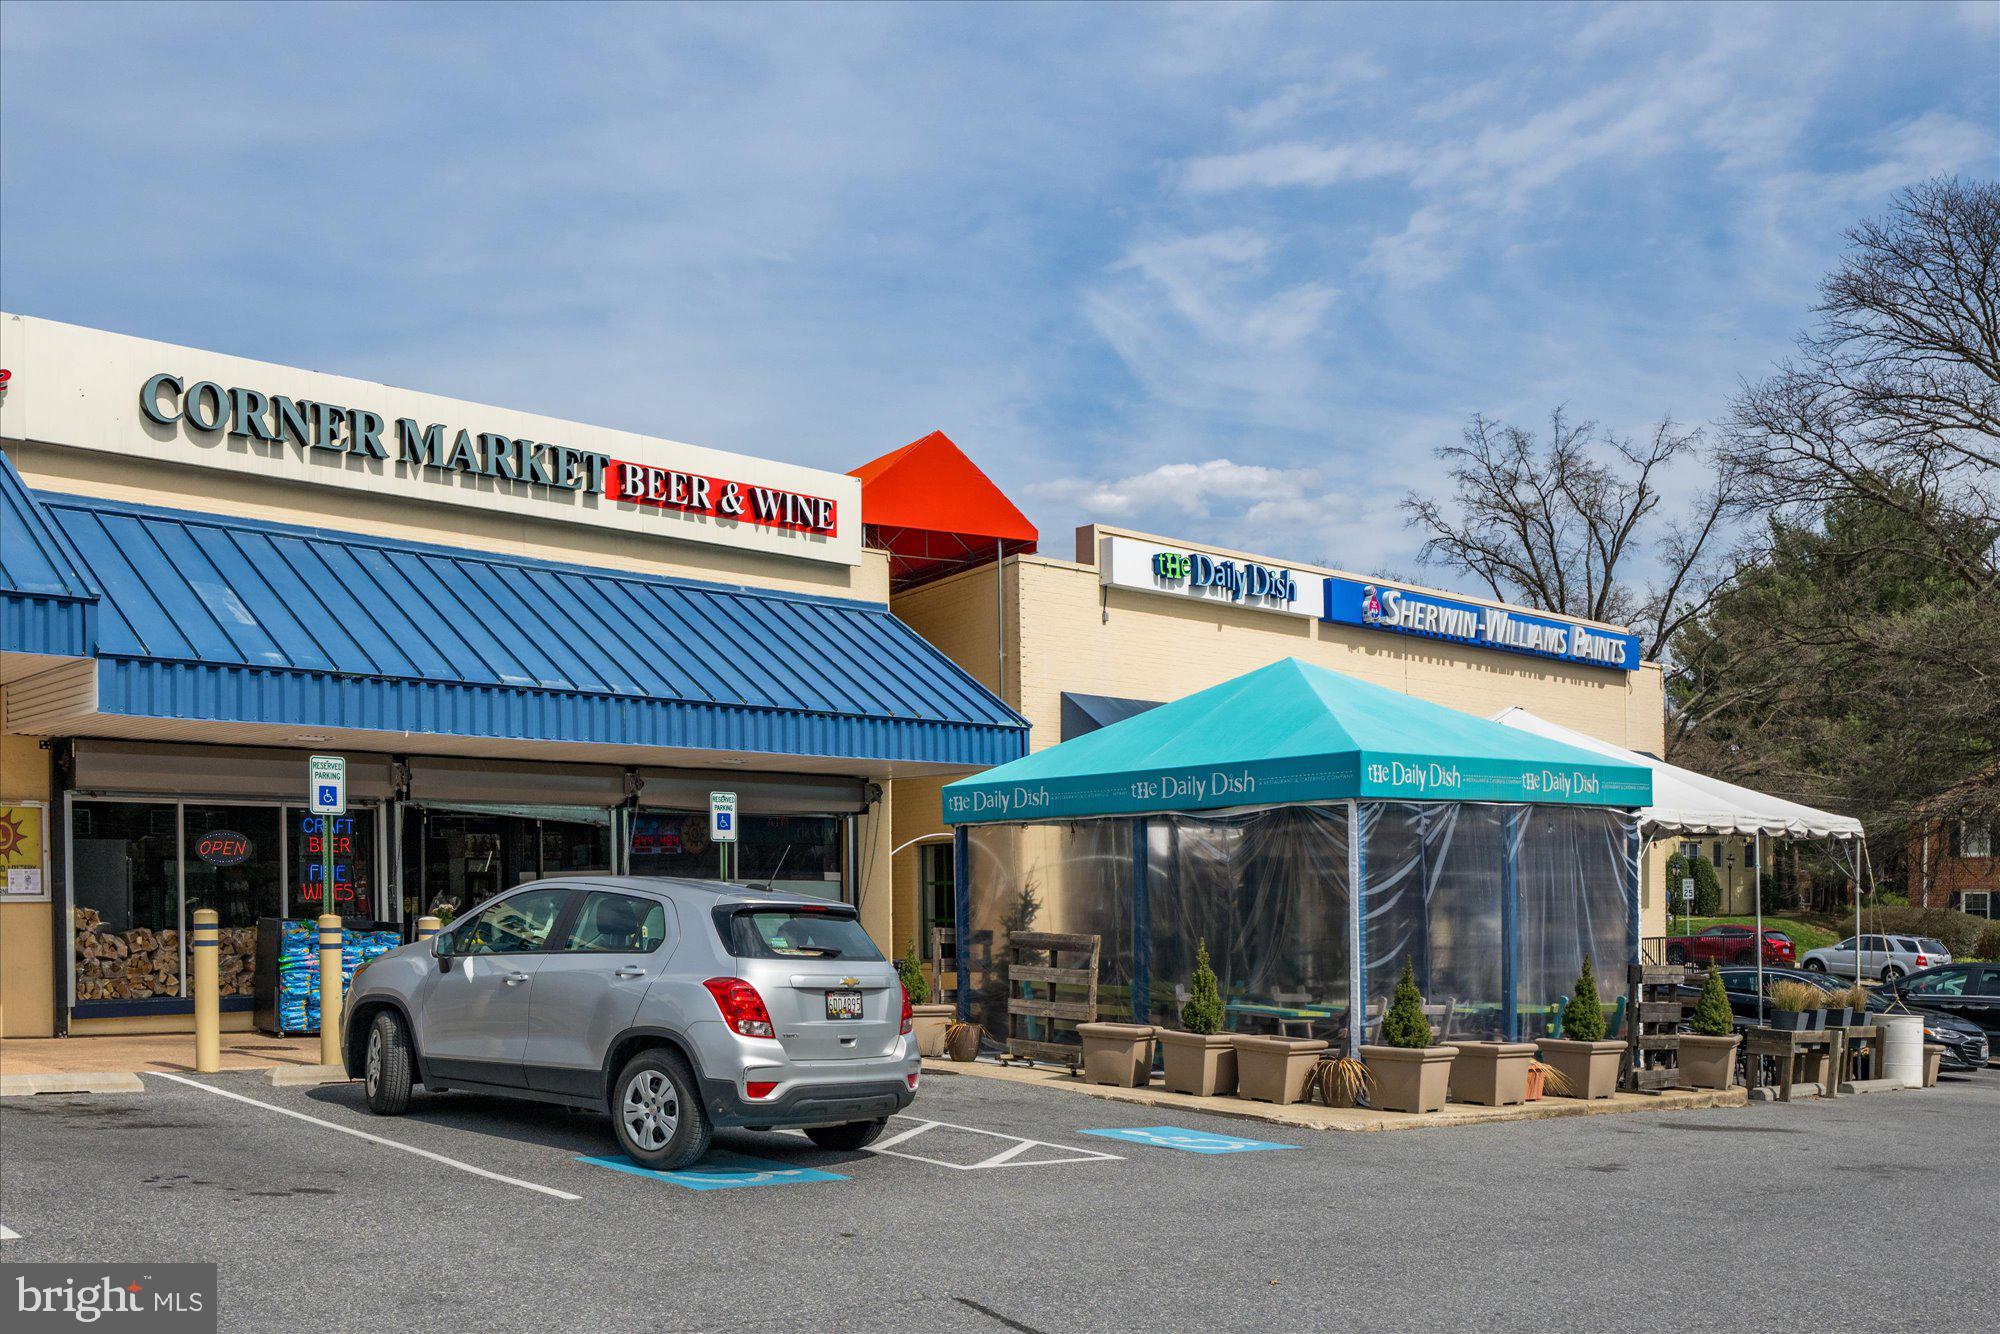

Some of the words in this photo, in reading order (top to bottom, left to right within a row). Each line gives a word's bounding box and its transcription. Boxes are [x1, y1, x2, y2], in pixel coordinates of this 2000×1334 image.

[140, 373, 389, 460] CORNER
[395, 417, 610, 493] MARKET
[619, 463, 712, 509] BEER
[719, 482, 745, 514] &
[750, 487, 833, 530] WINE
[1191, 554, 1247, 600] Daily
[1246, 563, 1297, 601] Dish
[1381, 590, 1567, 654] SHERWIN-WILLIAMS
[1570, 625, 1626, 663] PAINTS
[313, 761, 342, 771] RESERVED
[314, 771, 341, 780] PARKING
[1391, 762, 1426, 791] Daily
[1428, 763, 1460, 789] Dish
[1161, 776, 1205, 801] Daily
[1210, 770, 1255, 796] Dish
[1542, 771, 1570, 797] Daily
[1573, 772, 1600, 795] Dish
[712, 795, 735, 803] RESERVED
[973, 791, 1009, 813] Daily
[1014, 786, 1049, 808] Dish
[199, 839, 247, 856] OPEN
[310, 864, 345, 881] FIE
[301, 883, 354, 900] WIES
[1684, 889, 1693, 898] 25
